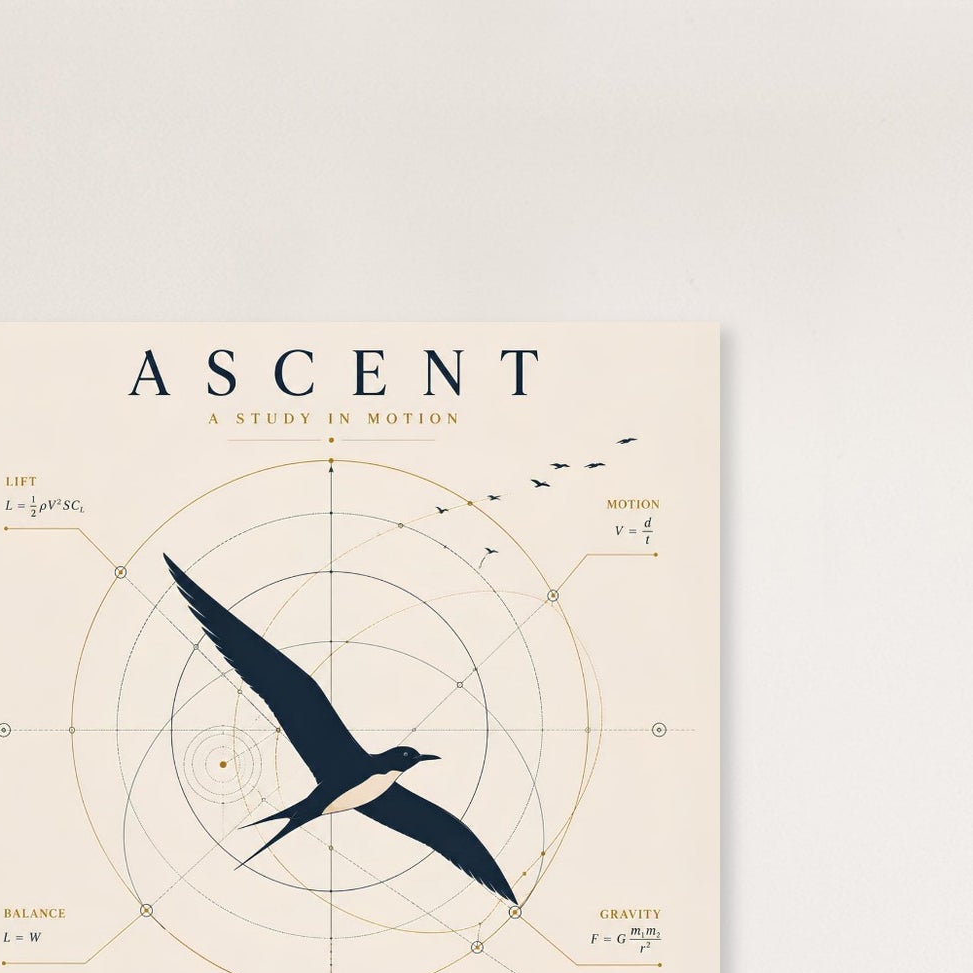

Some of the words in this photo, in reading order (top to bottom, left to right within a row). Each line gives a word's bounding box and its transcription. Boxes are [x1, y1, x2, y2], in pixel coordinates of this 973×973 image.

[128, 348, 540, 397] ASCENT
[208, 412, 219, 425] A
[235, 412, 311, 425] STUDY
[328, 412, 350, 425] IN
[367, 412, 459, 425] MOTION
[5, 476, 37, 487] LIFT
[5, 499, 13, 511] L
[607, 499, 660, 510] MOTION
[615, 525, 624, 536] V
[4, 908, 66, 919] BALANCE
[600, 909, 661, 920] GRAVITY
[3, 931, 11, 943] L
[29, 931, 42, 943] W
[590, 933, 600, 945] F
